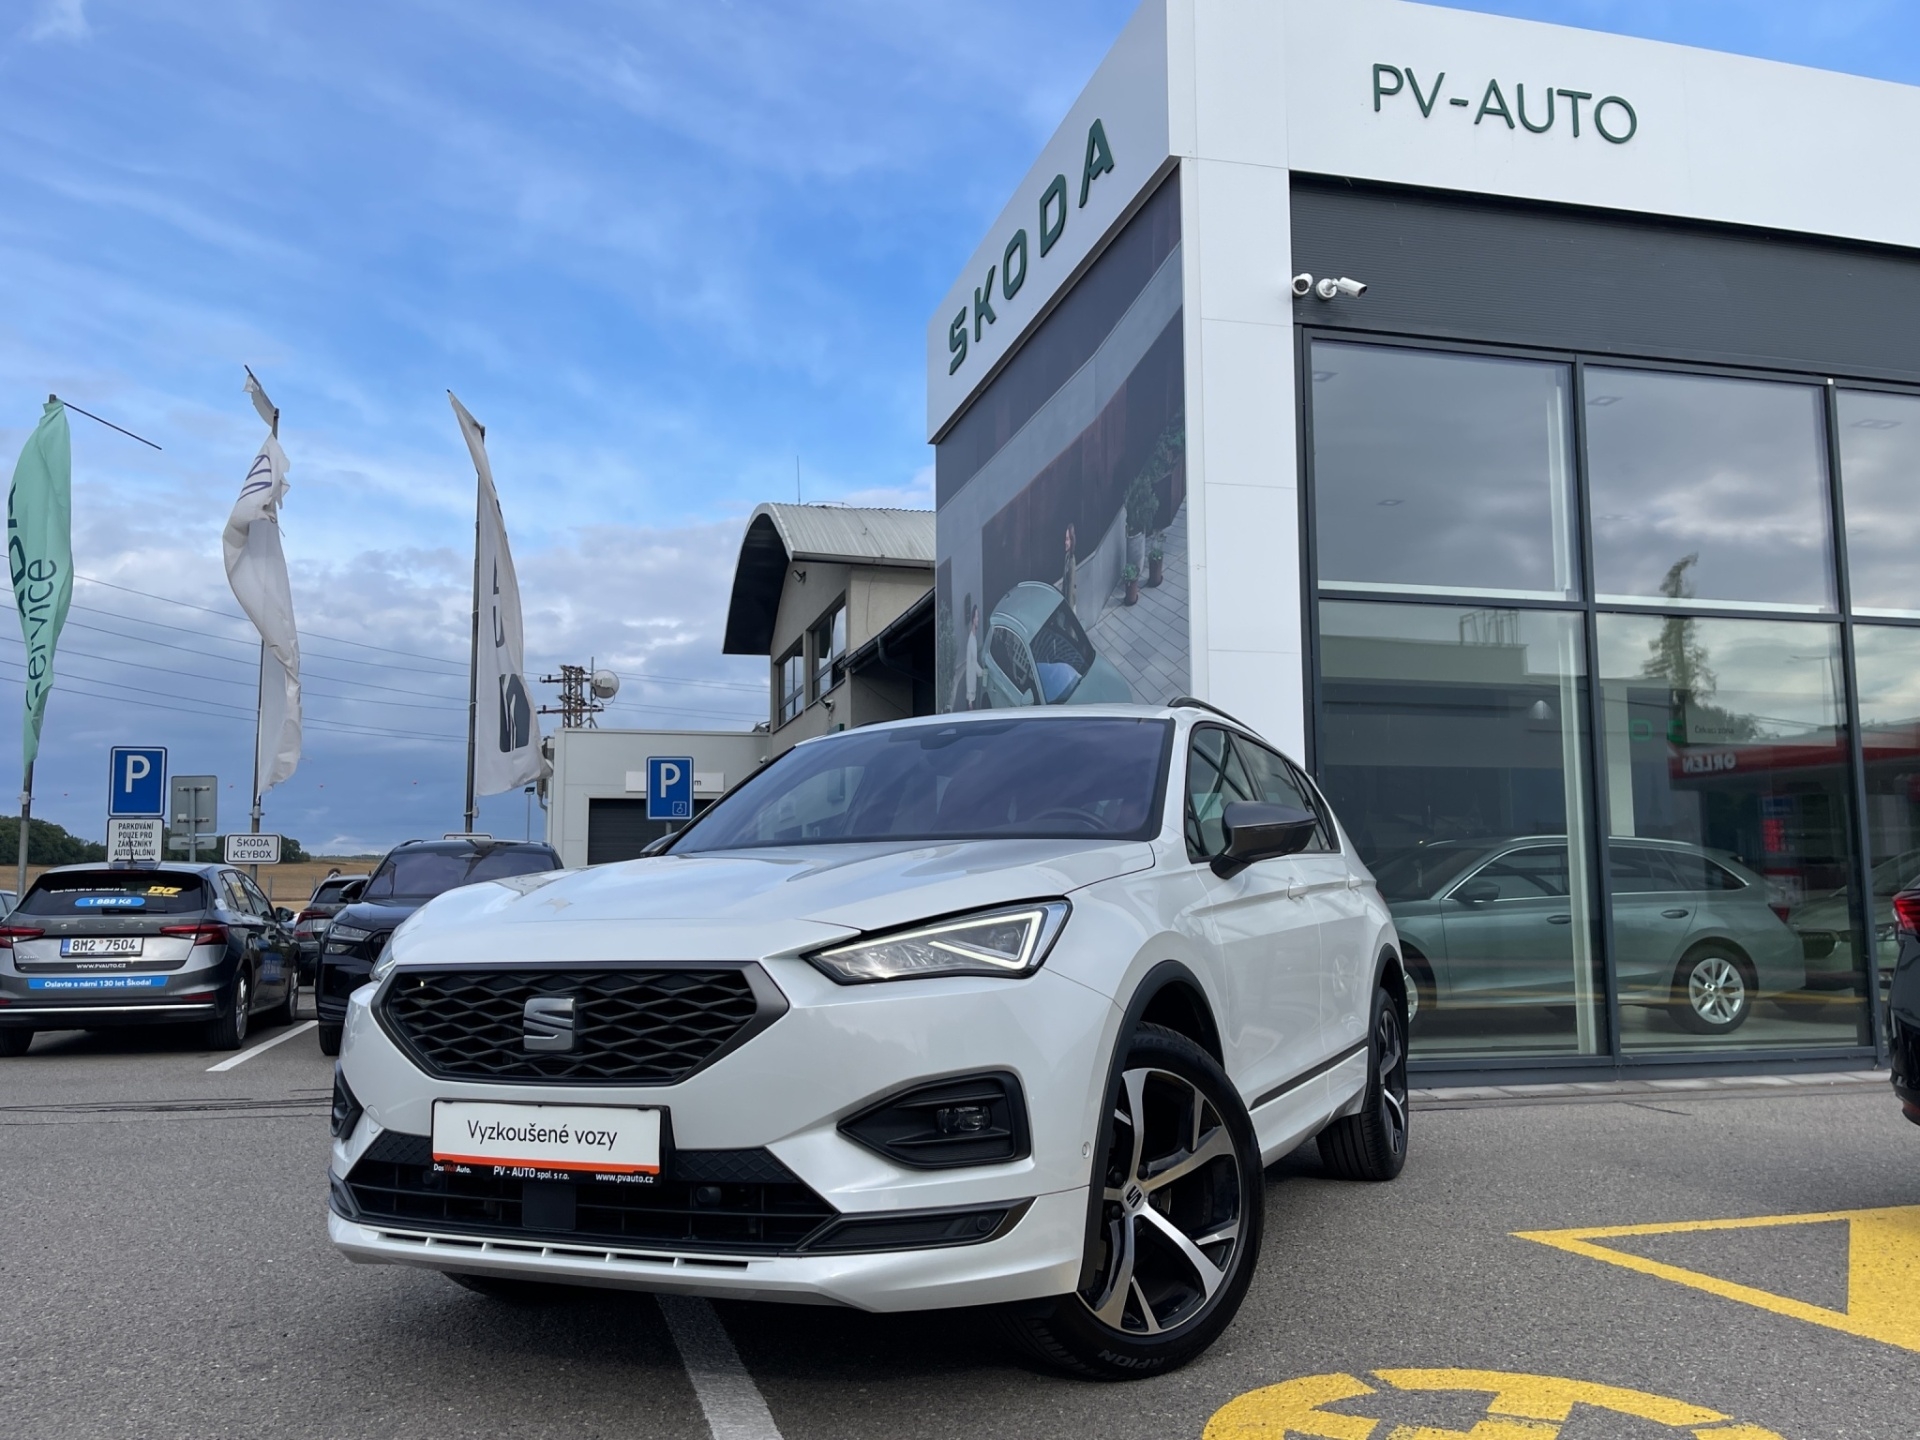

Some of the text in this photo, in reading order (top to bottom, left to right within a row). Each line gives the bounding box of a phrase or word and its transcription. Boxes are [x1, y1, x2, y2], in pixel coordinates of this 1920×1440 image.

[1372, 62, 1638, 144] PV-AUTO
[125, 754, 151, 793] P
[660, 762, 681, 798] P
[118, 822, 154, 831] PARKOVÁNÍ
[118, 831, 139, 839] POUZE
[117, 838, 152, 848] ZÁKAZNÍKY
[236, 837, 270, 847] ŠKODA
[232, 850, 272, 859] KEYBOX
[72, 939, 136, 951] 8M2 7504
[44, 980, 73, 988] Oslavte
[467, 1119, 618, 1151] Vyzkoušené vozy
[493, 1165, 505, 1176] PV
[511, 1167, 536, 1178] AUTO
[536, 1171, 553, 1181] spol.
[558, 1173, 570, 1181] r.o.
[595, 1172, 654, 1184] www.pvauto.cz
